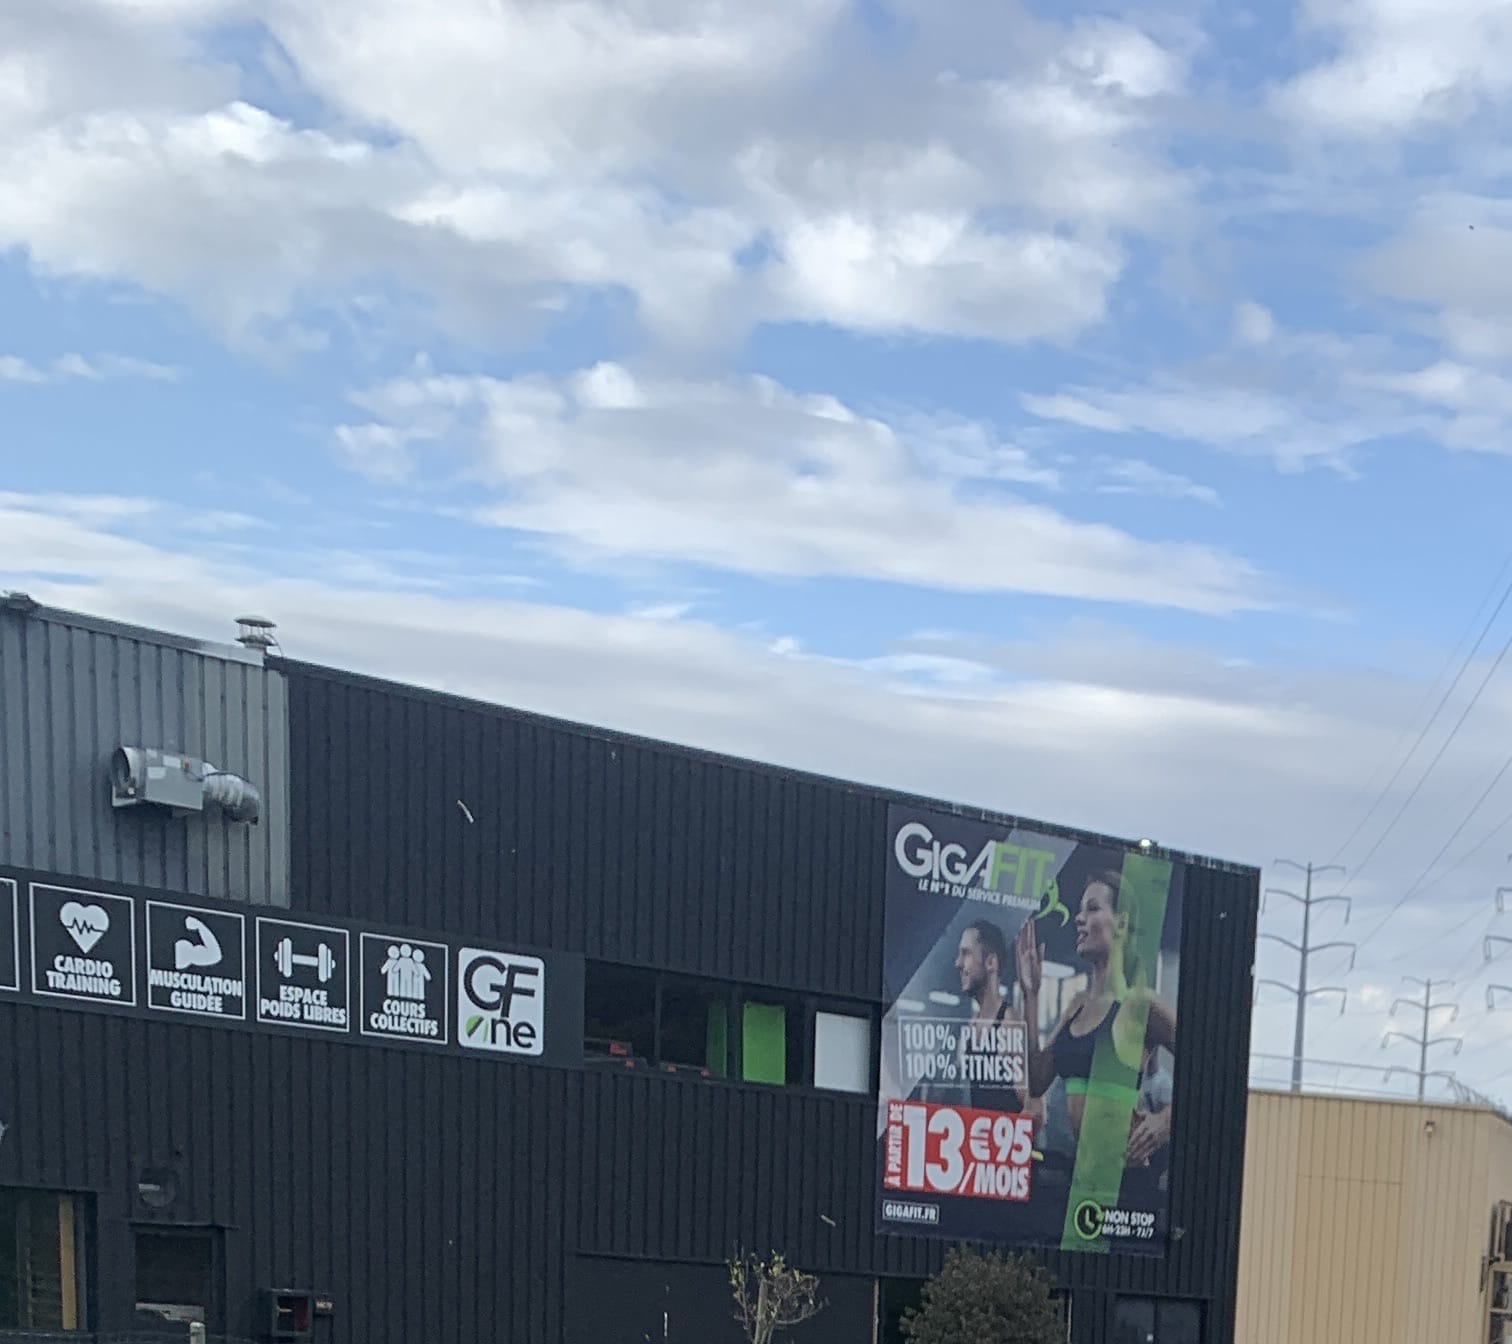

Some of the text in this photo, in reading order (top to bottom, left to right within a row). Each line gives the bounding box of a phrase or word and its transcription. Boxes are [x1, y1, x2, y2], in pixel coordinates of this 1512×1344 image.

[895, 822, 1055, 898] GIGAFIT
[54, 955, 113, 978] CARDIO
[46, 970, 121, 996] TRAINING
[150, 969, 242, 997] MUSCULATION
[279, 985, 328, 1006] ESPACE
[464, 955, 539, 1018] GF
[261, 999, 346, 1025] POIDS LIBRES
[382, 999, 426, 1019] COURS
[370, 1013, 438, 1036] COLLECTIFS
[904, 1023, 1024, 1053] 100% PLAISIR
[905, 1053, 1024, 1082] 100% FITNESS
[885, 1204, 937, 1221] GIGAFIT.FR
[1105, 1208, 1155, 1226] NON STOP
